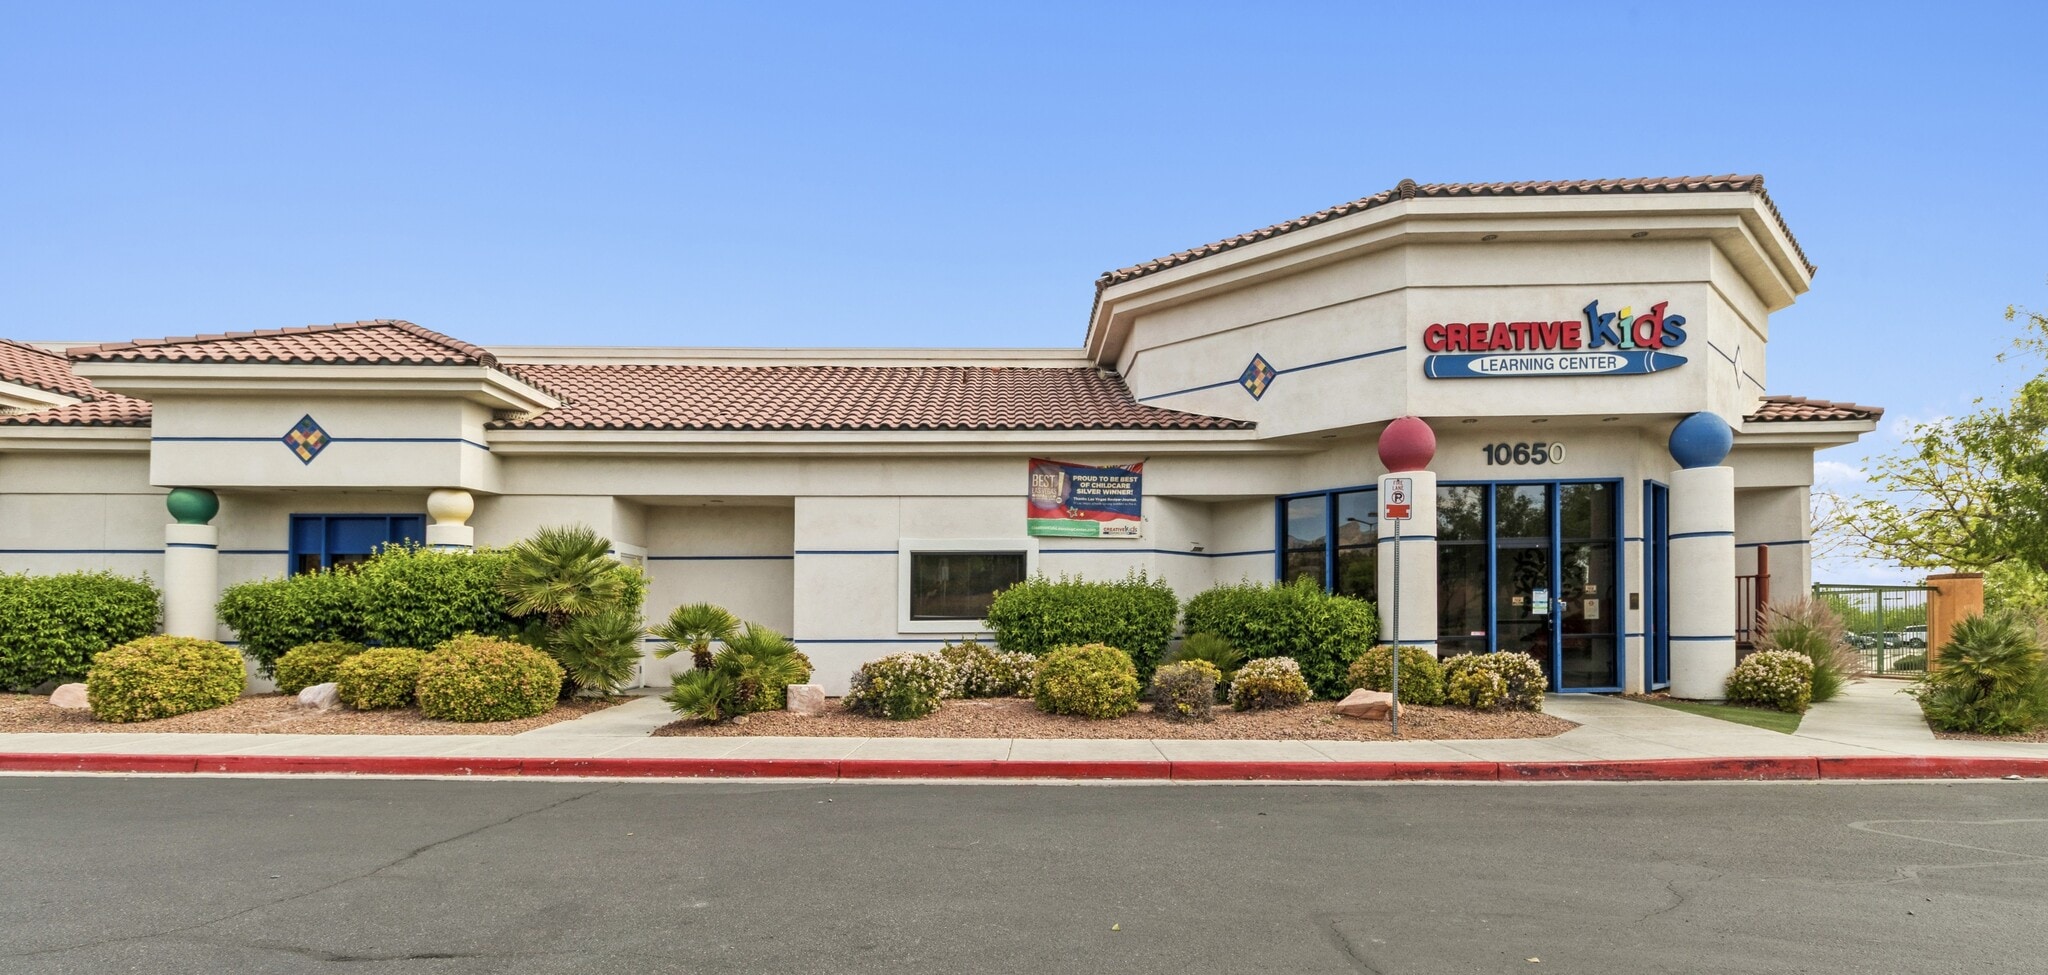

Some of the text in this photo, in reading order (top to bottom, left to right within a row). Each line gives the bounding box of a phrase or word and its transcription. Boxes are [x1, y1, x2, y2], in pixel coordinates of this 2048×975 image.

[1424, 299, 1687, 352] CREATIVE kids
[1480, 355, 1617, 372] LEARNING CENTER
[1483, 442, 1566, 465] 10650
[1032, 474, 1055, 487] BEST
